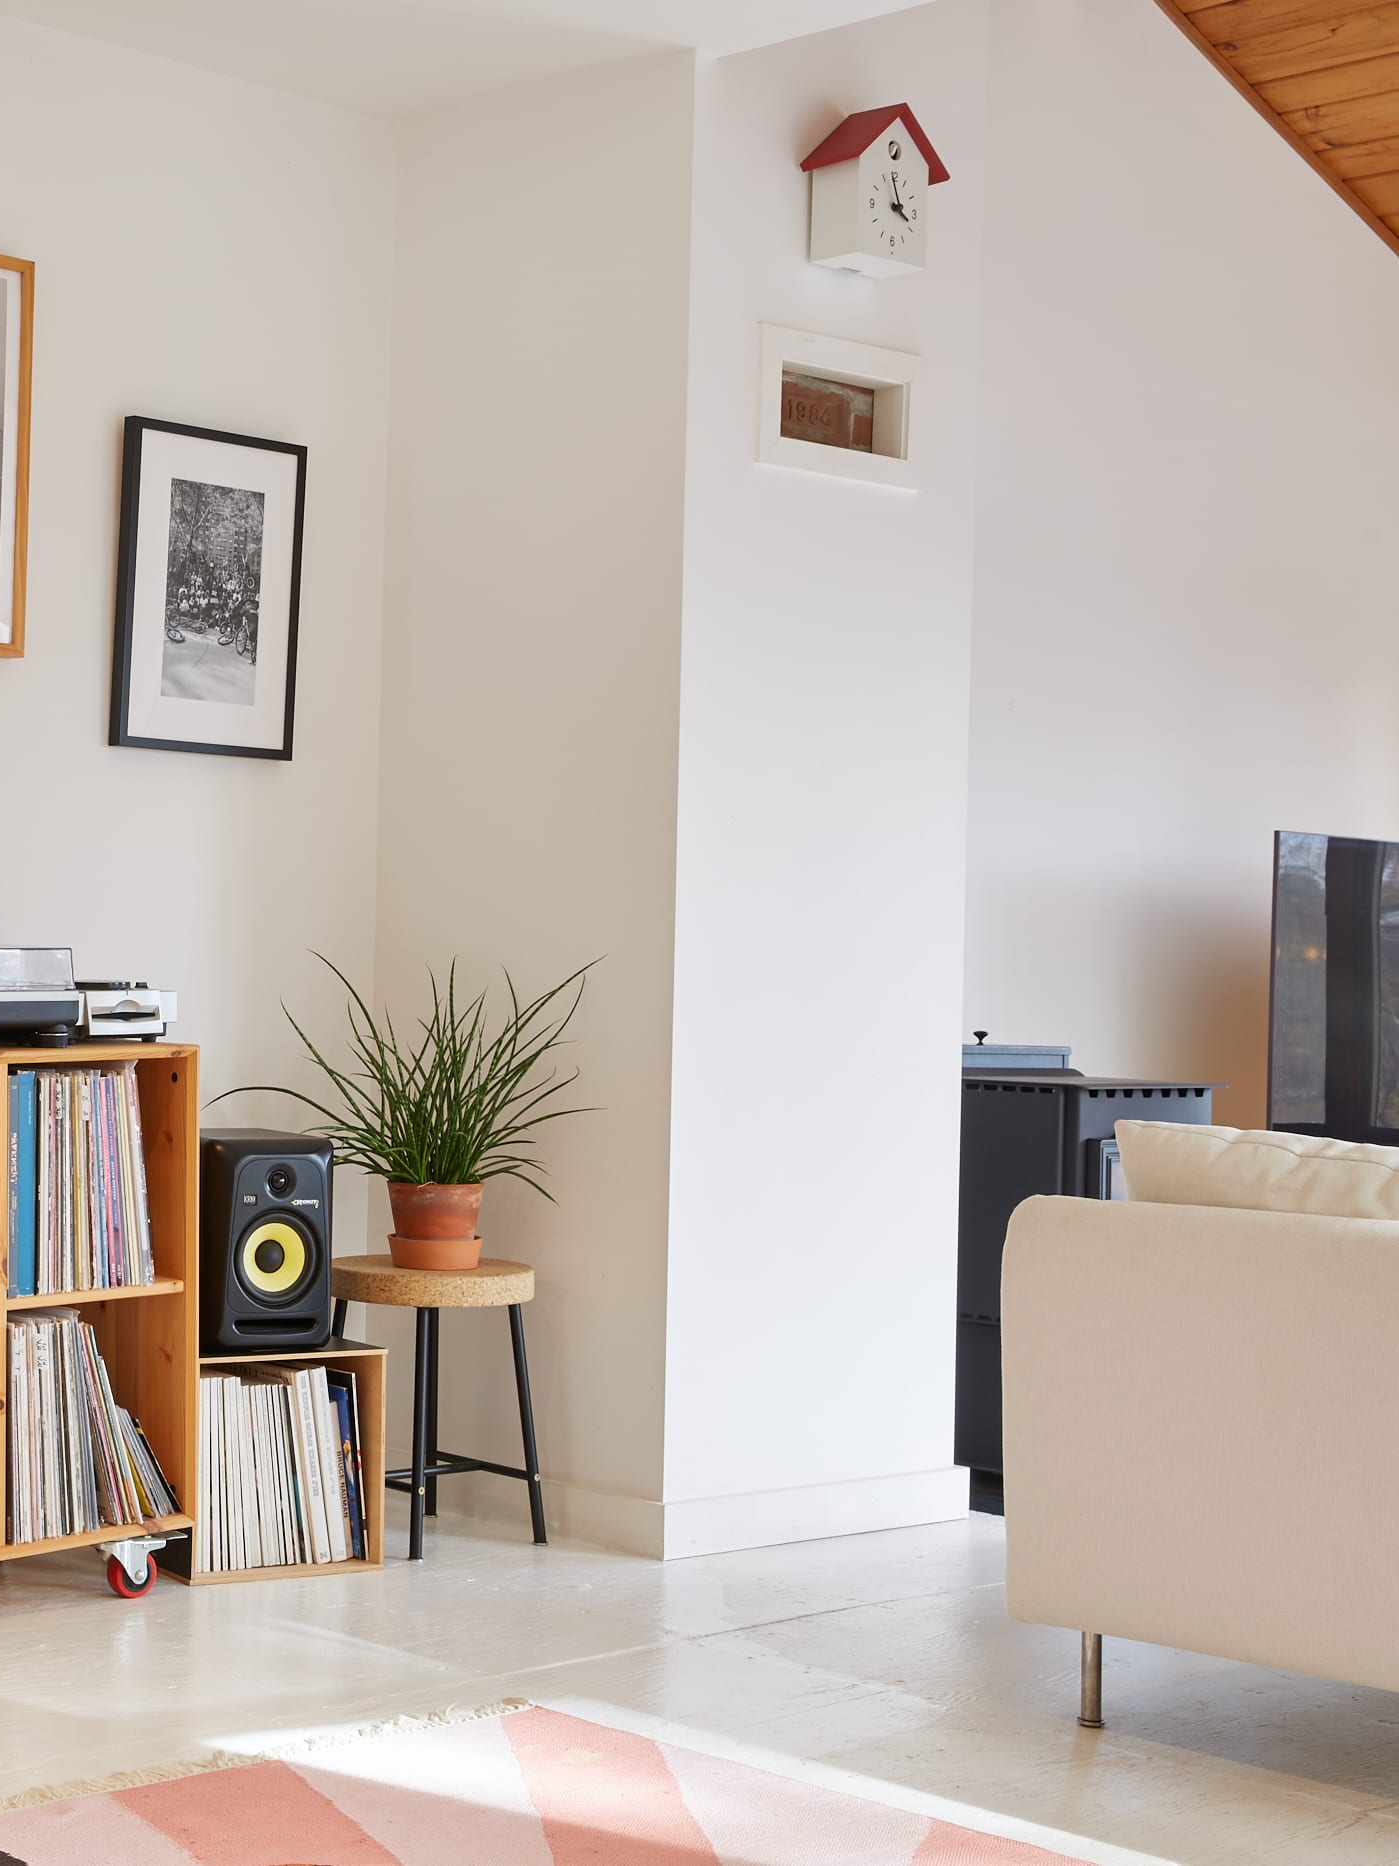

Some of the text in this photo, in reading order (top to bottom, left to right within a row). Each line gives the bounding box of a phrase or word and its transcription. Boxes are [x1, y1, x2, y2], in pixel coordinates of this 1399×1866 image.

[869, 198, 875, 209] 9
[911, 209, 917, 220] 3
[889, 236, 895, 247] 6
[336, 1450, 349, 1519] BRUCE NAUMAN
